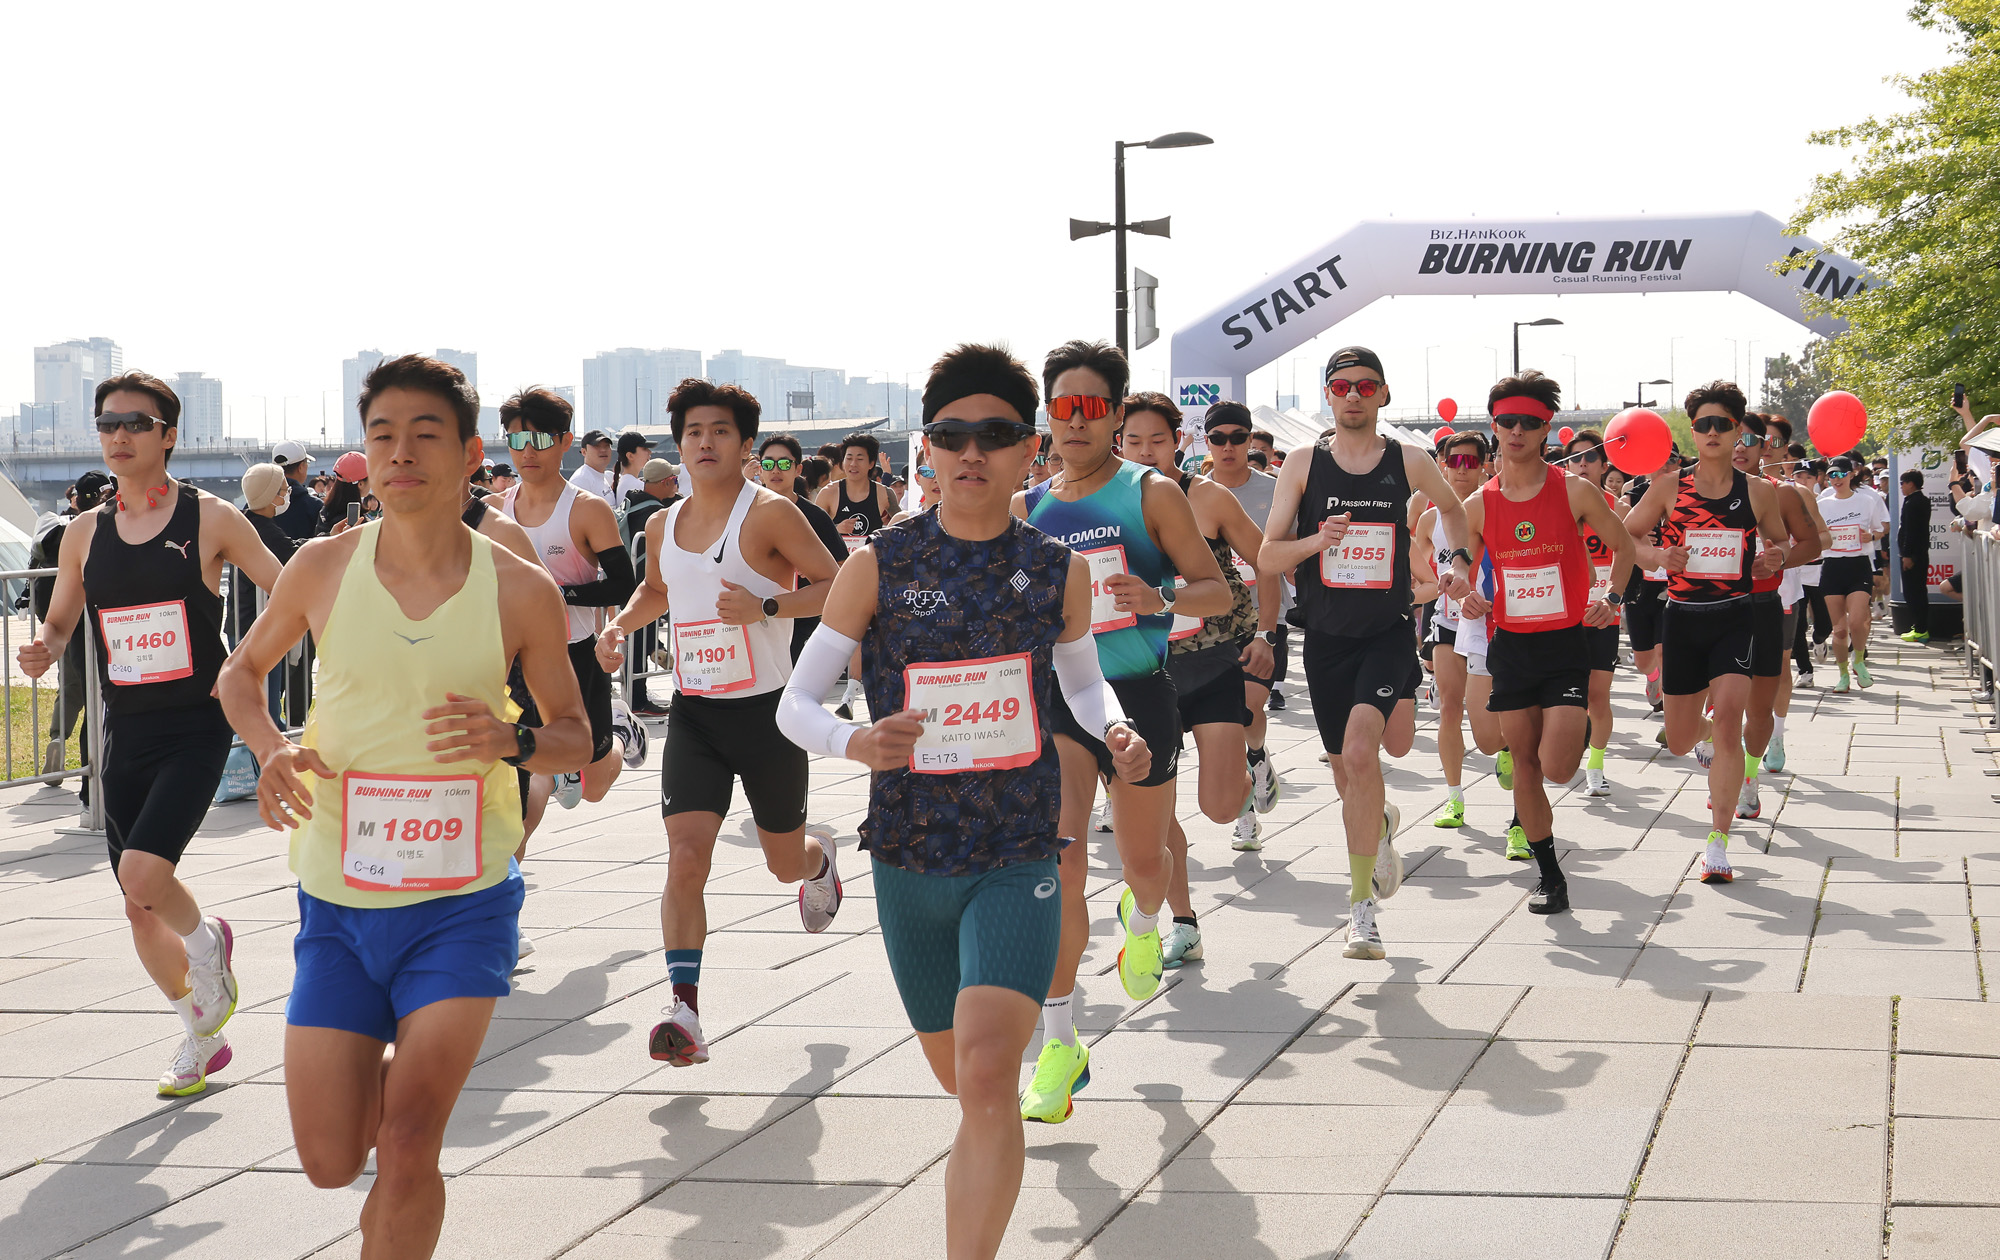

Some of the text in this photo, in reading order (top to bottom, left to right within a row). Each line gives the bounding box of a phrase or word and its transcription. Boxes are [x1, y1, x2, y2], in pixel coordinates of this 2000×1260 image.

[1419, 239, 1692, 274] BURNING RUN
[1553, 273, 1681, 284] Casual Running Festival
[1221, 254, 1348, 350] START
[1340, 500, 1371, 508] PASSION
[1372, 500, 1393, 509] FIRST
[1053, 525, 1121, 546] LOMON
[1328, 546, 1386, 560] M 1955
[1690, 546, 1736, 557] M 2464
[1098, 556, 1117, 564] 10km
[1337, 572, 1355, 580] F-82
[1508, 584, 1555, 599] M 2457
[903, 590, 949, 608] RFA
[107, 614, 135, 624] BURNING
[135, 612, 151, 620] RUN
[159, 610, 178, 618] 10km
[910, 607, 936, 618] Japan
[112, 630, 176, 651] M 1460
[684, 645, 735, 663] M 1901
[112, 664, 132, 673] C-240
[998, 668, 1022, 678] 10km
[687, 677, 702, 686] B-38
[916, 671, 988, 685] BURNING RUN
[921, 697, 1020, 726] M 2449
[941, 729, 1006, 743] KAITO IWASA
[922, 752, 959, 764] E-173
[355, 786, 433, 799] BURNING RUN
[444, 788, 471, 797] 10km
[357, 817, 463, 842] M 1809
[396, 849, 425, 860] 이병도
[354, 860, 385, 876] C-64
